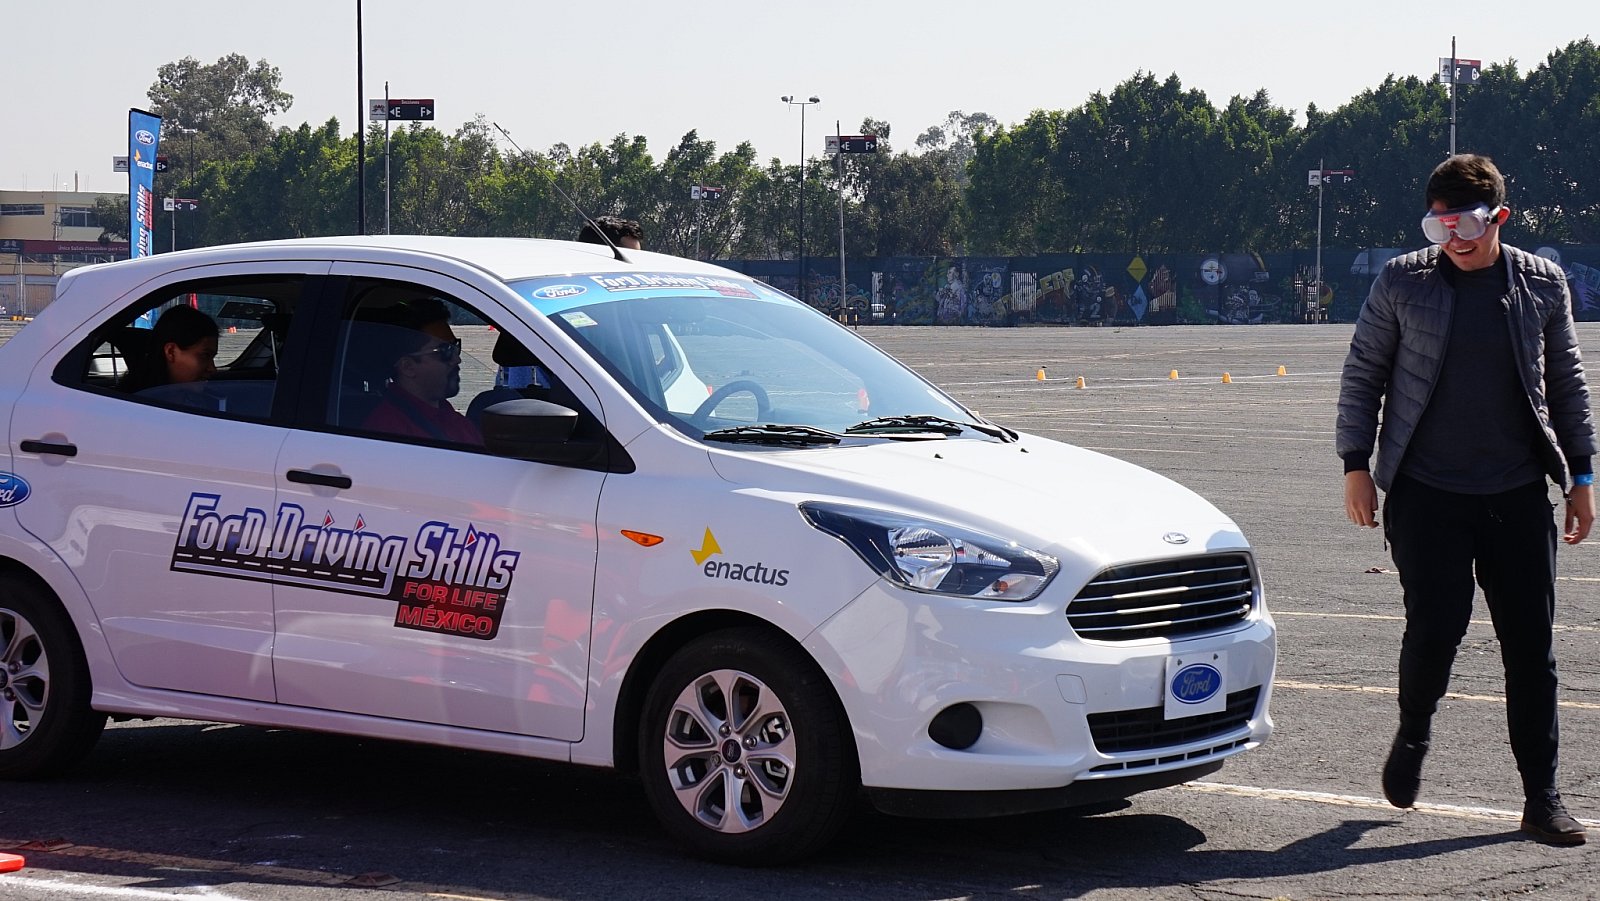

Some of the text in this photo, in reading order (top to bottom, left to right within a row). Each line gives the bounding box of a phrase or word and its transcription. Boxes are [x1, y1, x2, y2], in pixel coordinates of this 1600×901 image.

[395, 106, 426, 118] E F
[543, 285, 580, 298] Ford
[267, 502, 408, 596] Driving
[408, 522, 521, 591] Skills
[703, 560, 790, 587] enactus
[402, 582, 499, 611] FOR LIFE
[397, 604, 493, 636] MÉXICO
[1180, 669, 1212, 699] Ford
